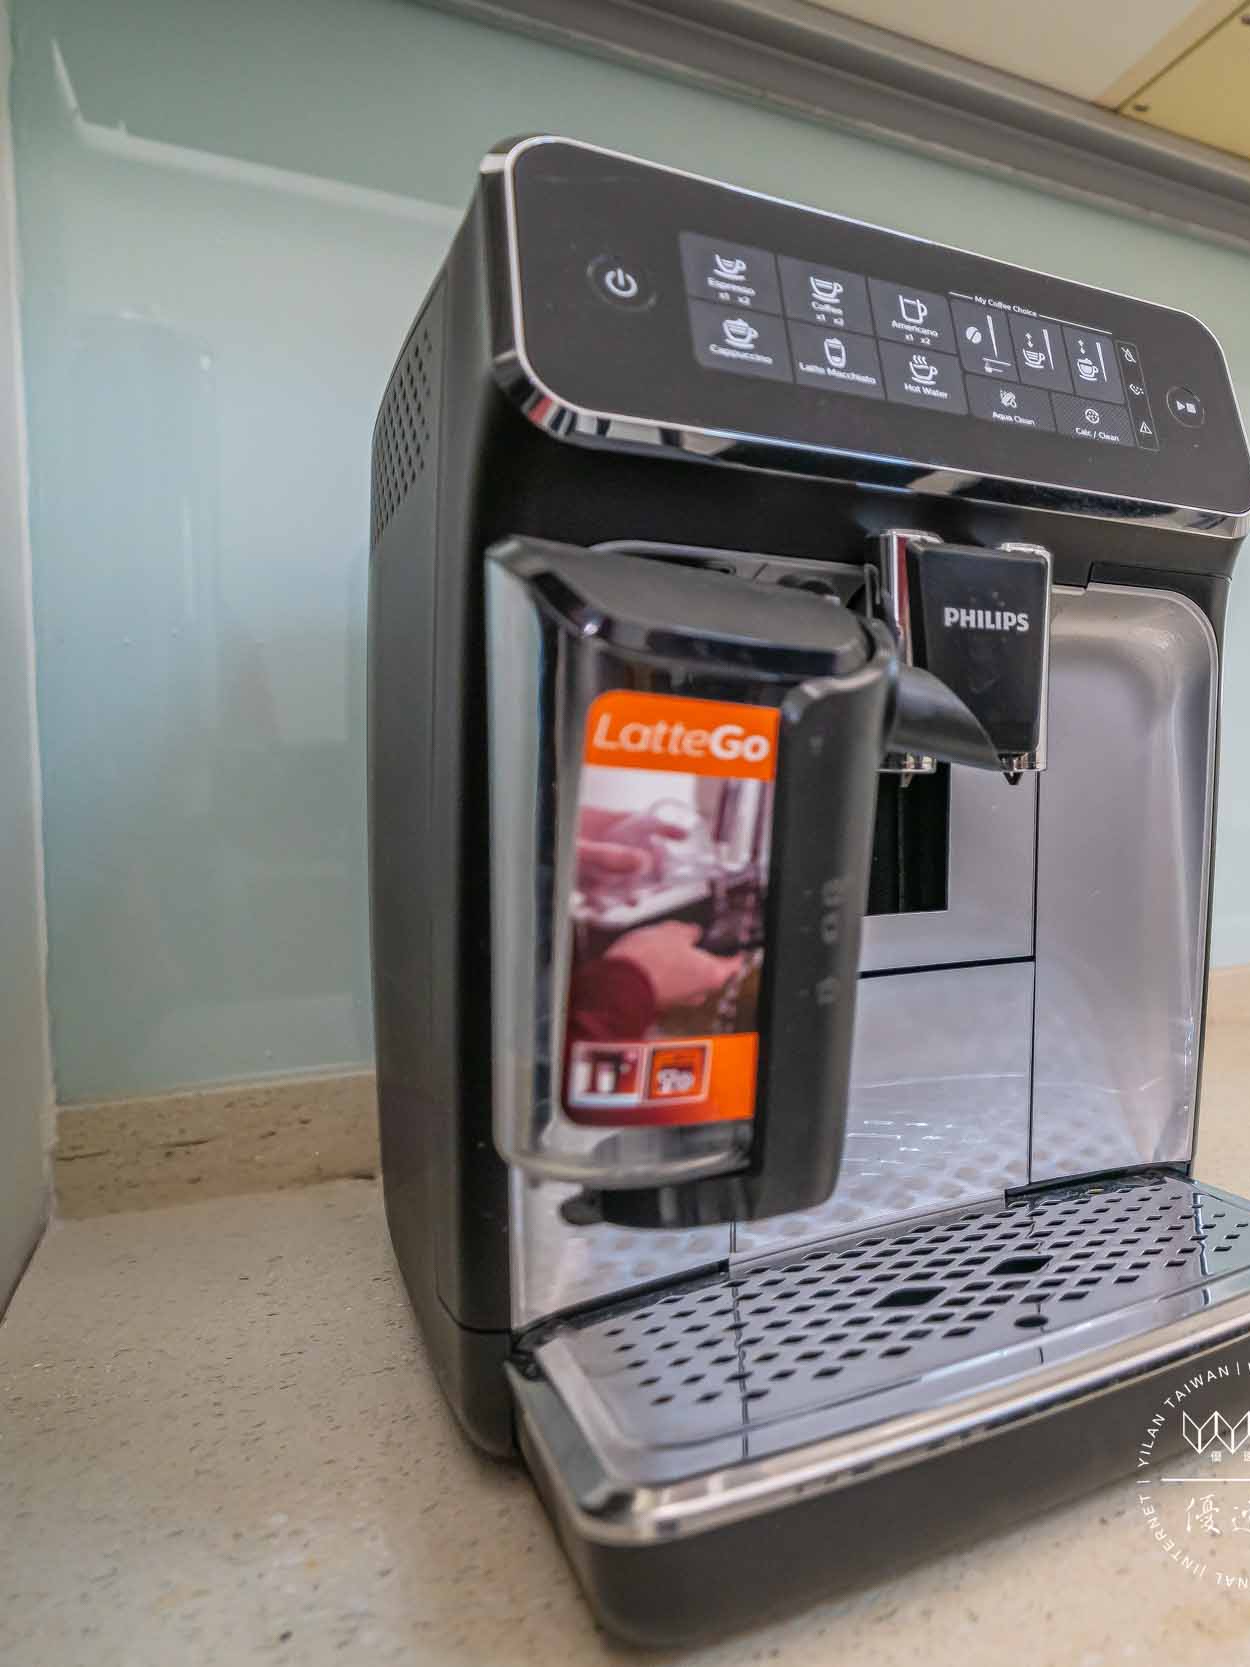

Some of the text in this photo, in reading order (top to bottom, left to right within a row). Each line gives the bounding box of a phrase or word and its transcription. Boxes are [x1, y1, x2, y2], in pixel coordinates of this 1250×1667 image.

[974, 295, 1038, 317] My Coffee Choice
[891, 319, 939, 337] Americano
[709, 343, 774, 365] Cappuccino
[827, 367, 877, 385] Macchiato
[904, 382, 949, 399] Hot Water
[992, 411, 1035, 427] Aqua Clean
[1075, 427, 1092, 438] Calc
[1099, 431, 1120, 442] Clean
[944, 607, 1030, 632] PHILIPS
[592, 712, 770, 762] LatteGo
